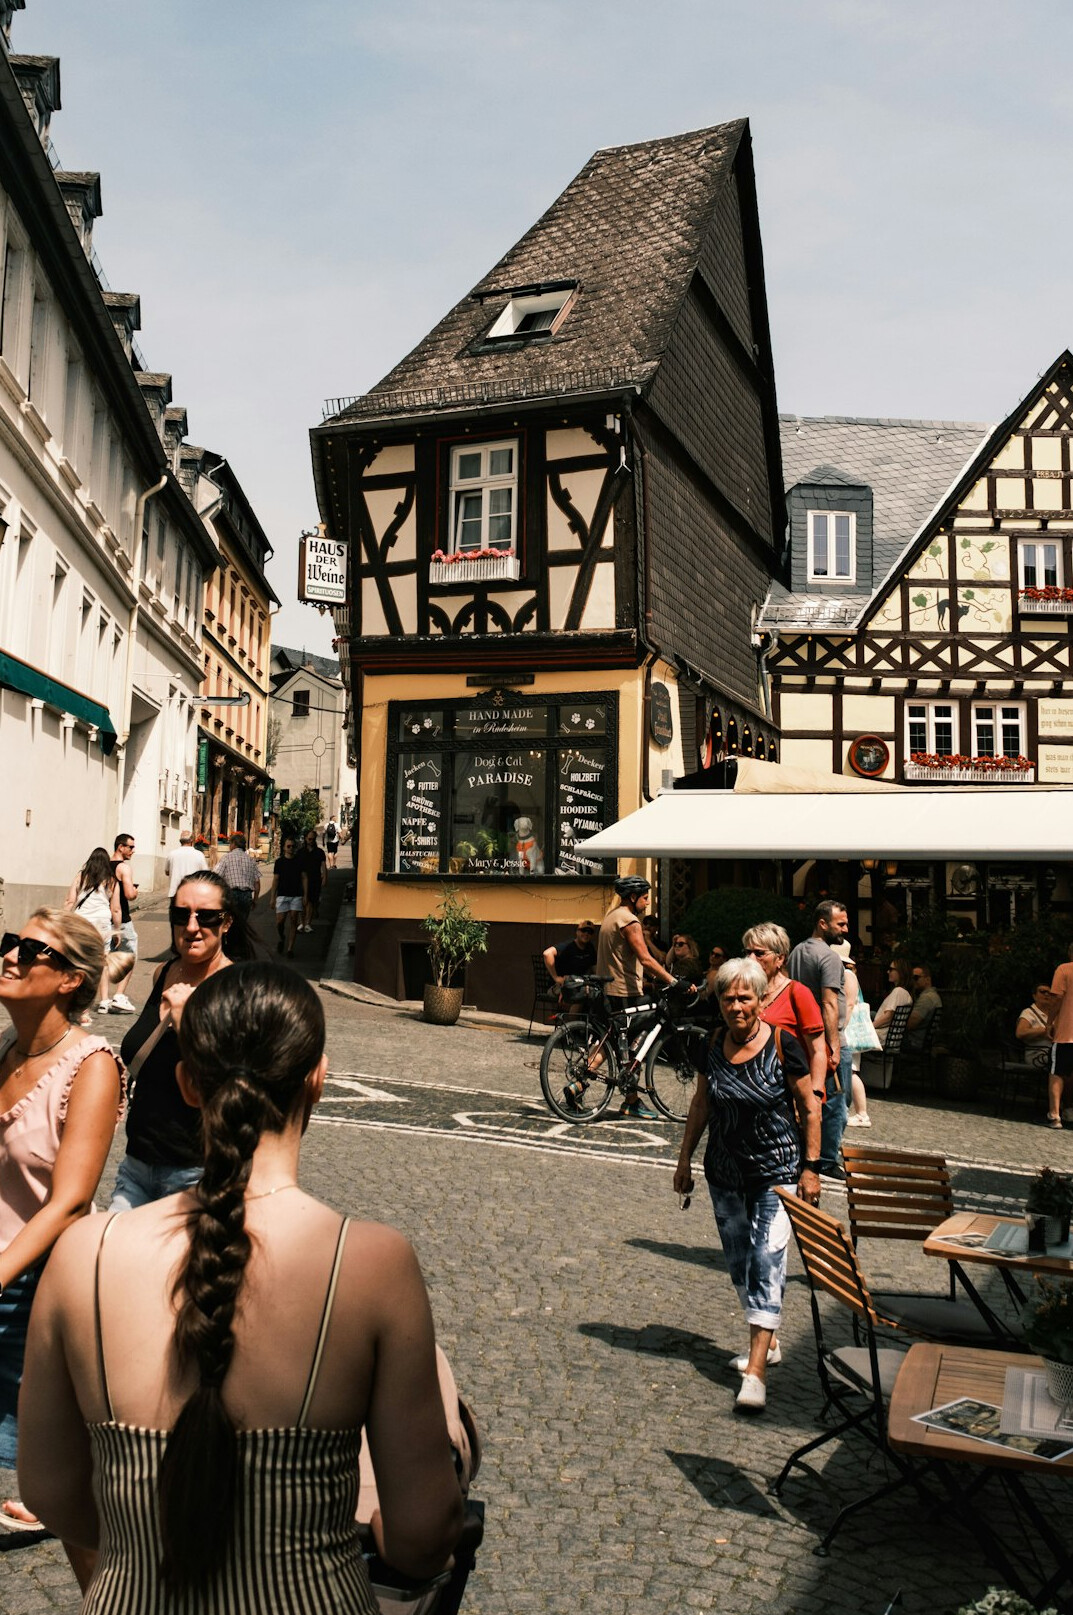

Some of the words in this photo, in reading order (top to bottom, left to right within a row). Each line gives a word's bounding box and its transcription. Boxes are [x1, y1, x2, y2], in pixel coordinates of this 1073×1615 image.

[310, 541, 344, 556] HAUS
[316, 555, 338, 566] DER
[308, 563, 345, 584] Weine
[307, 586, 344, 597] SPIRITUOSEN
[469, 711, 500, 720] HAND
[502, 709, 533, 718] MADE
[474, 755, 496, 770] Dog
[496, 757, 504, 767] &
[505, 756, 523, 767] Cat
[403, 760, 426, 779] Jacken
[467, 772, 533, 789] PARADISE
[570, 773, 600, 782] HOLZBETT
[418, 781, 439, 791] FUTTER
[405, 801, 441, 818] APOTHEKE
[560, 805, 598, 814] HOODIES
[401, 816, 428, 826] NÄPFE
[573, 817, 604, 832] PYJAMAS
[411, 836, 438, 846] T-SHIRTS
[468, 858, 492, 869] Mary
[493, 858, 500, 868] &
[500, 858, 528, 869] Jessie
